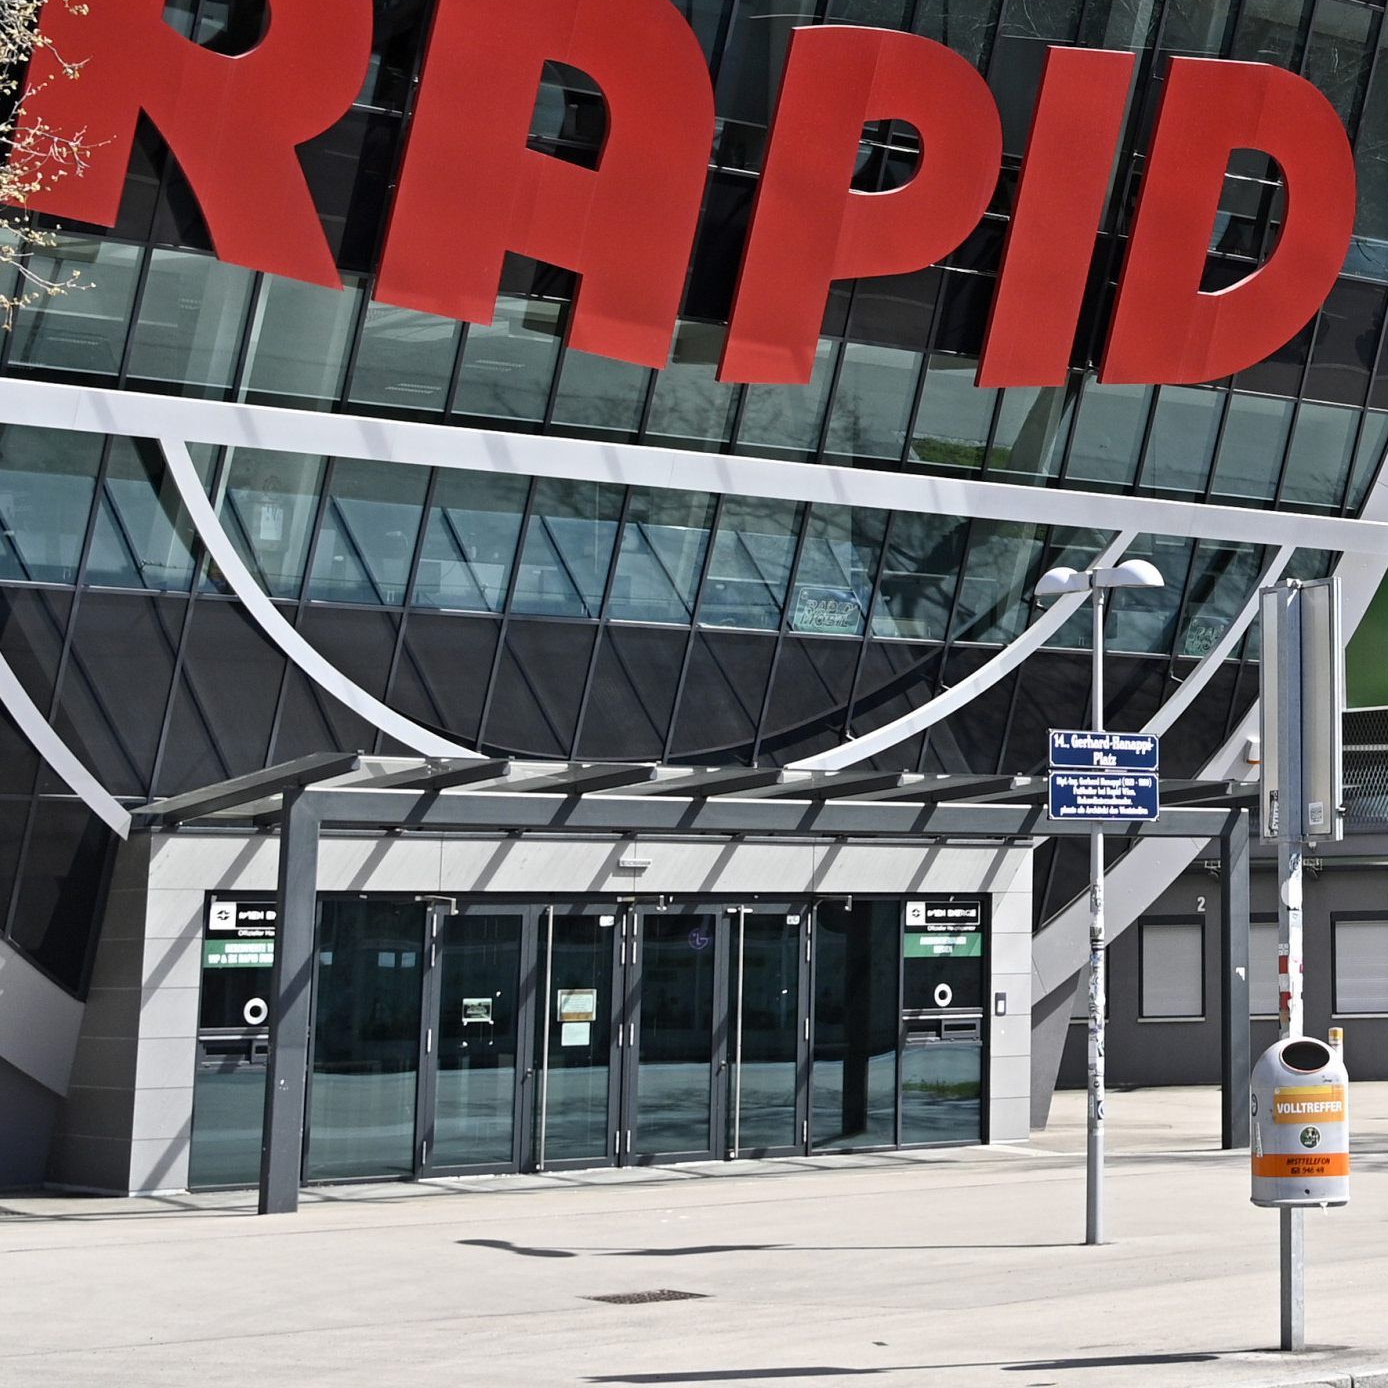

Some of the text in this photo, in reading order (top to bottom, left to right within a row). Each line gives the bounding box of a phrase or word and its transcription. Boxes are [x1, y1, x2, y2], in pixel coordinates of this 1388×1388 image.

[1071, 734, 1154, 755] Gerhard-Hanappi-
[1093, 751, 1117, 766] Platz
[1197, 896, 1206, 912] 2
[1277, 1101, 1342, 1114] VOLLTREFFER
[1286, 1157, 1330, 1165] MISTTELEFON
